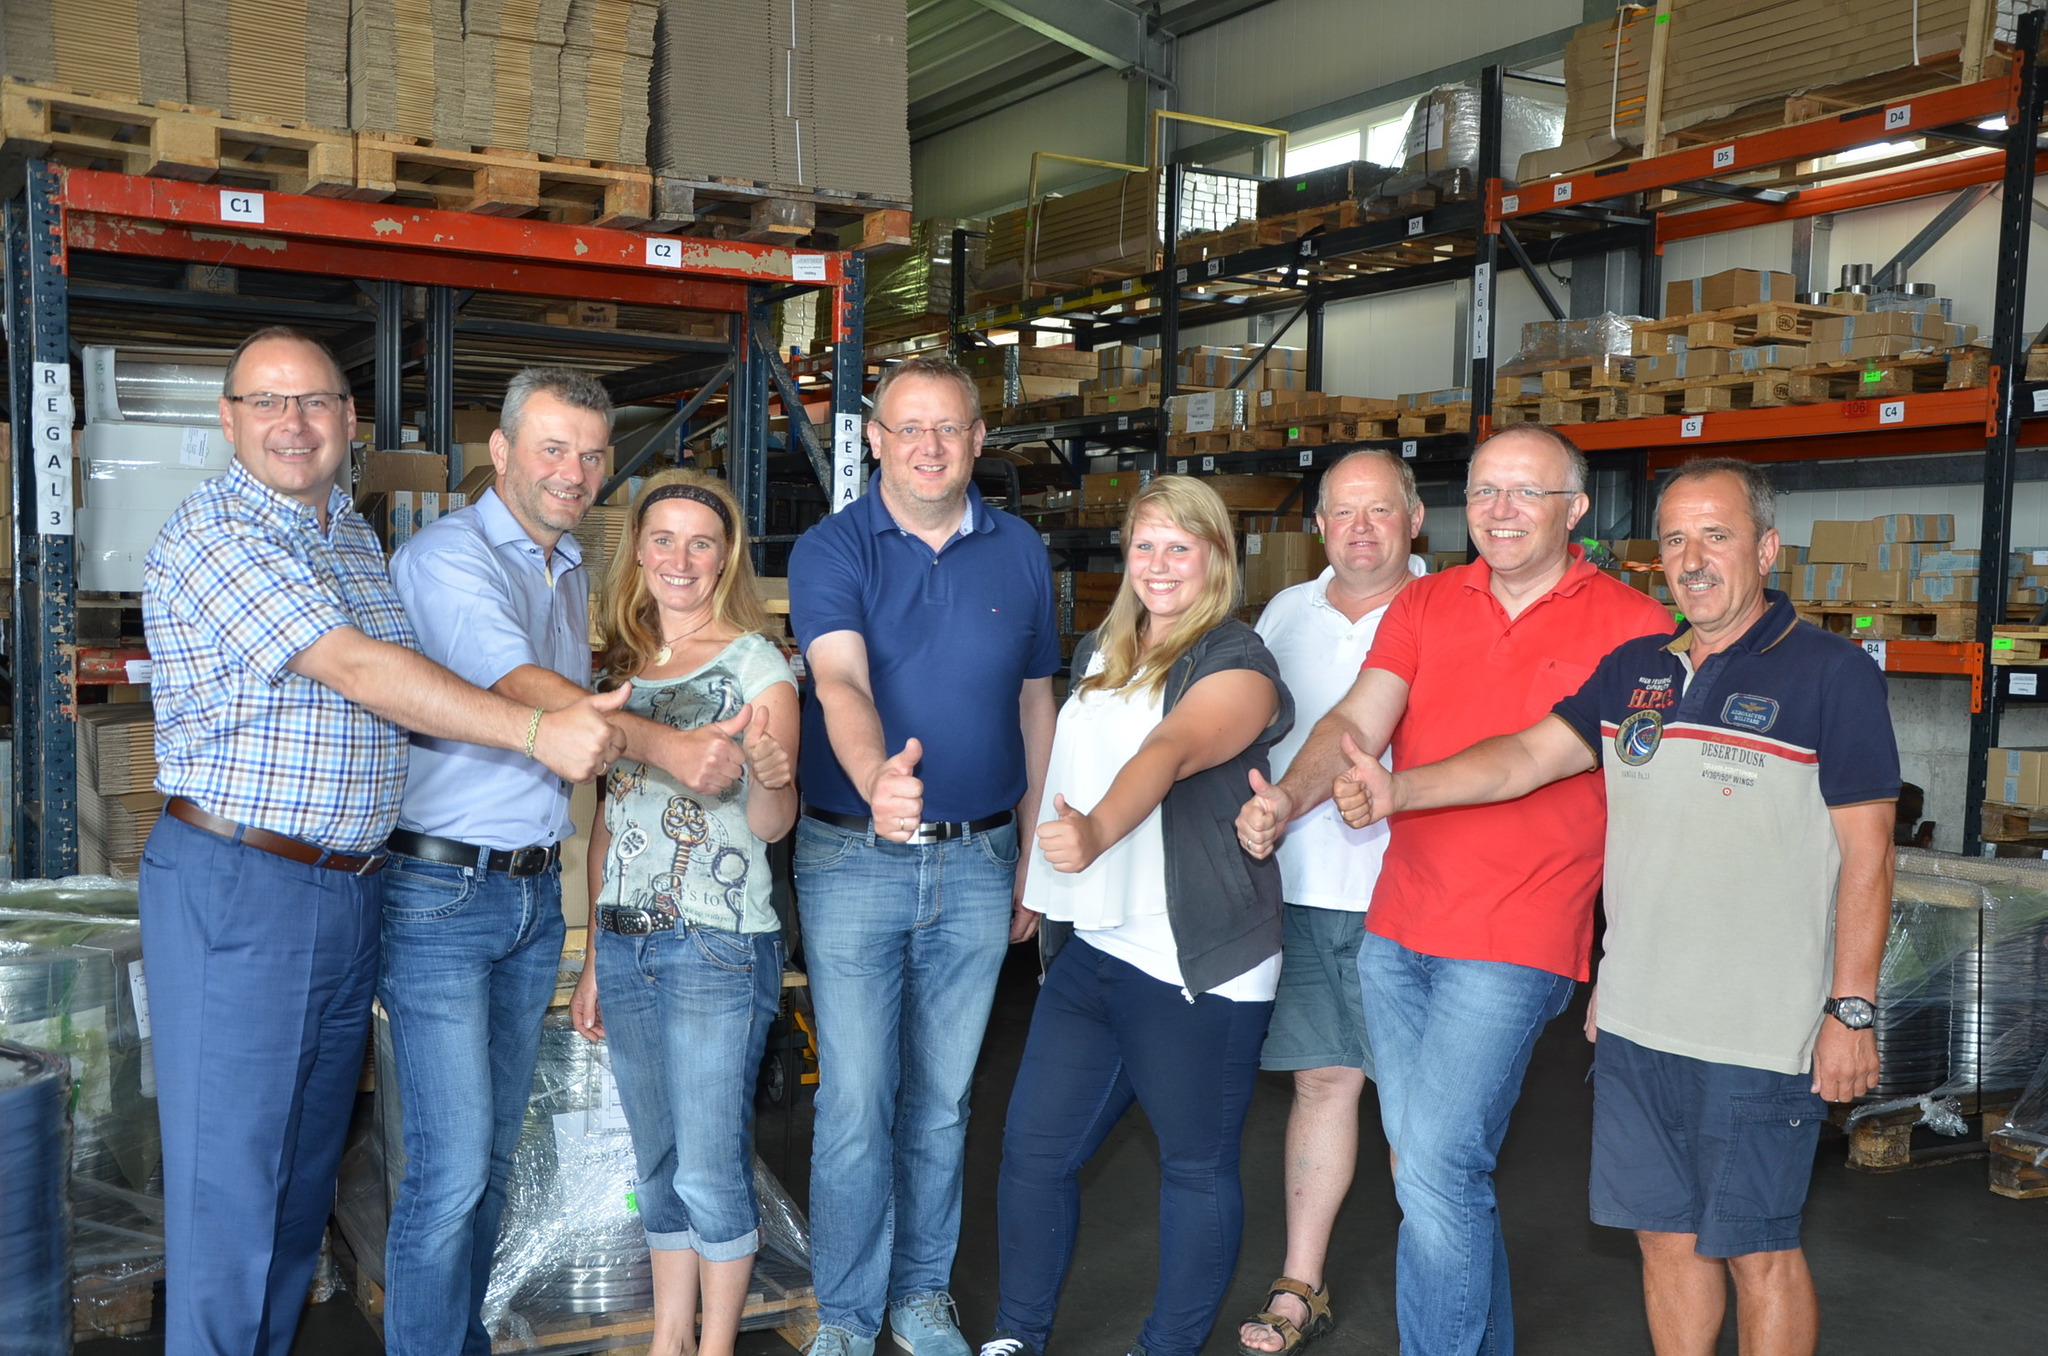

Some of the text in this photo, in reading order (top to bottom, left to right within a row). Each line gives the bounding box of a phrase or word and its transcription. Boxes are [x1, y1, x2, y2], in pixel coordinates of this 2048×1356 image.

[1890, 111, 1904, 123] D4
[1717, 151, 1729, 162] D5
[1557, 186, 1568, 196] D6
[230, 198, 252, 213] C1
[1411, 221, 1420, 230] D7
[654, 244, 671, 257] C2
[1778, 317, 1793, 329] EPAL
[1847, 402, 1865, 413] 106
[1885, 406, 1897, 417] C4
[1686, 421, 1696, 431] C5
[44, 369, 62, 525] REGAL 3
[1405, 444, 1413, 453] C7
[1867, 643, 1879, 653] B4
[1701, 742, 1767, 768] DESERT DUSK
[1733, 775, 1755, 787] WINGS
